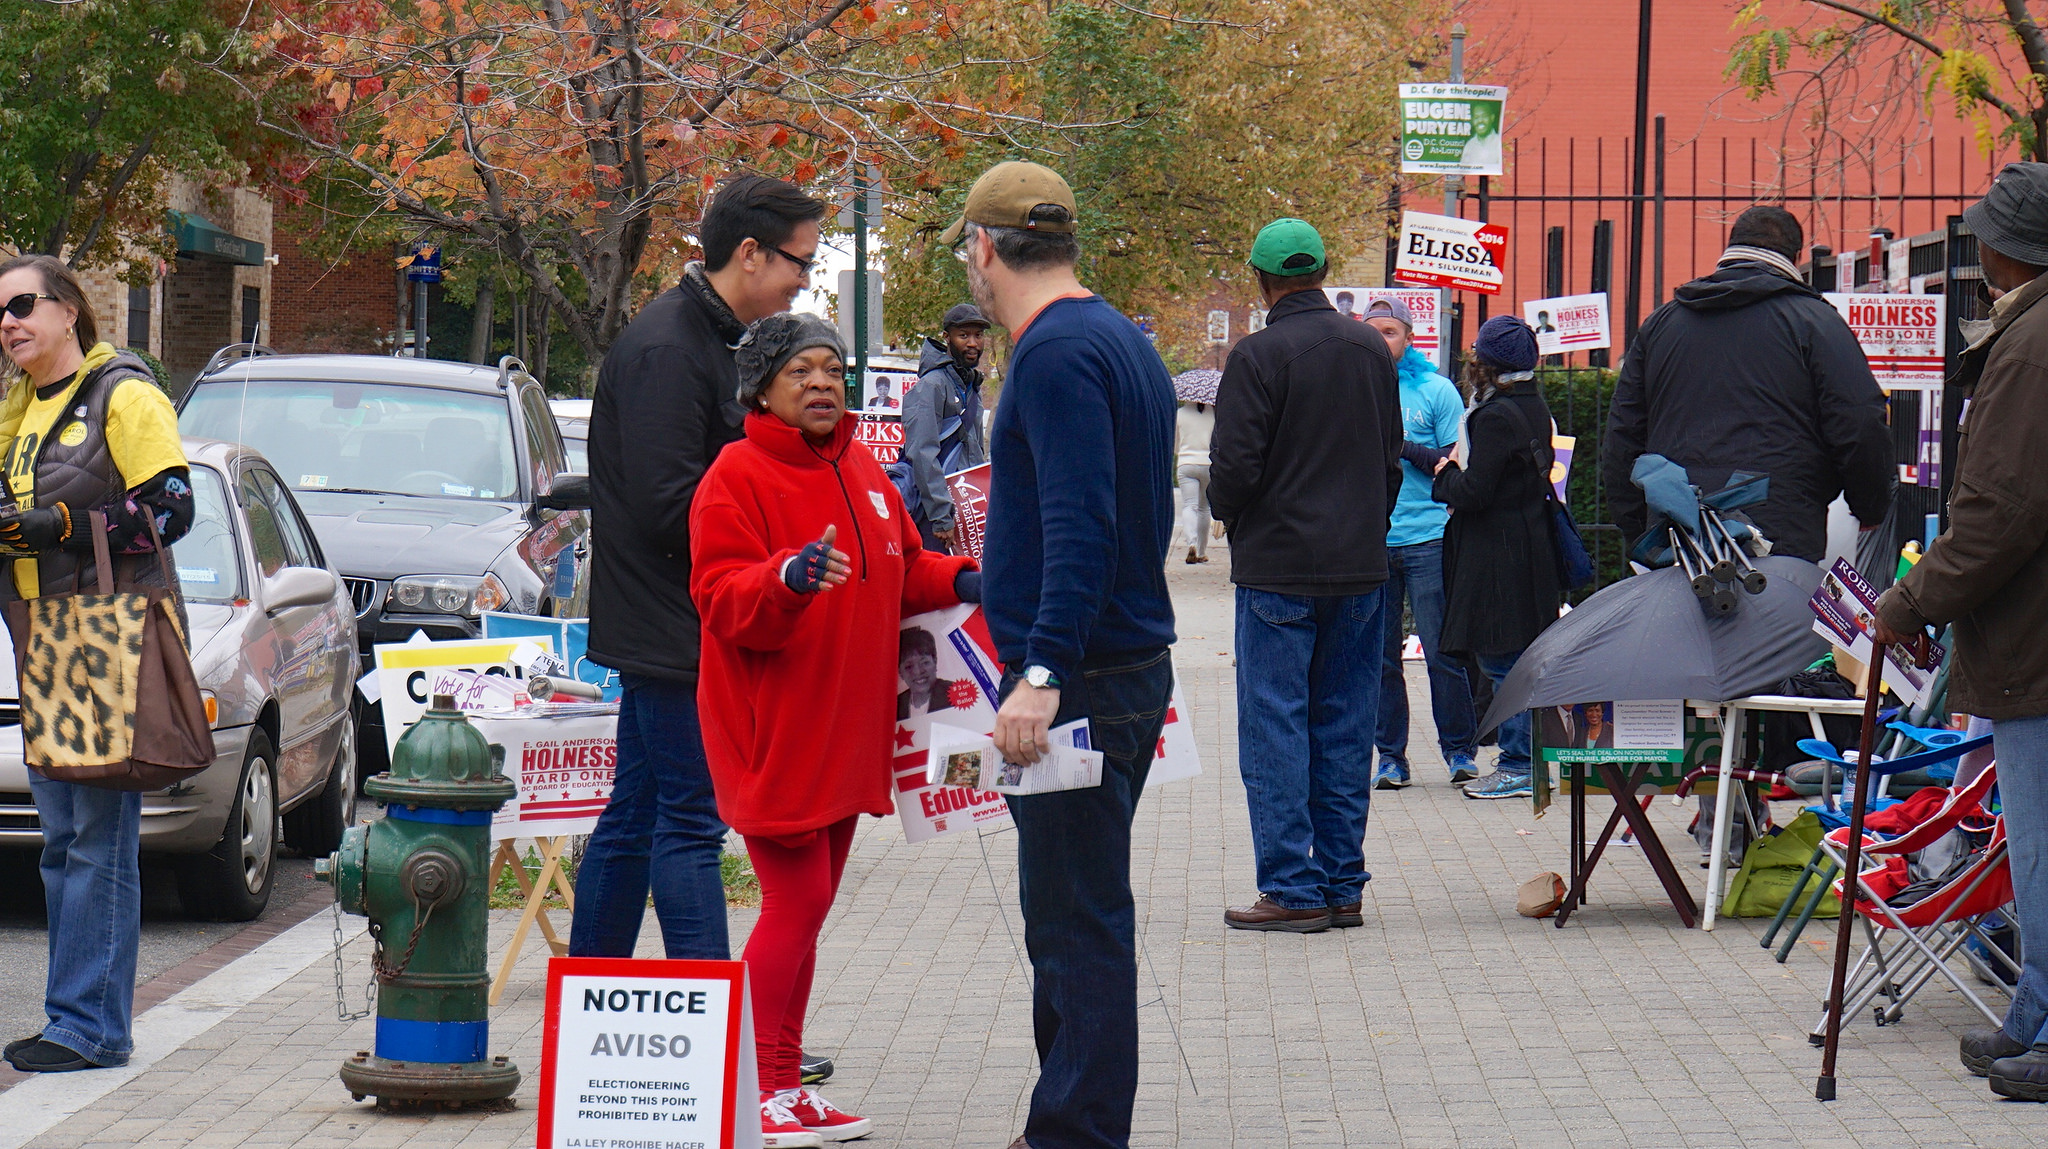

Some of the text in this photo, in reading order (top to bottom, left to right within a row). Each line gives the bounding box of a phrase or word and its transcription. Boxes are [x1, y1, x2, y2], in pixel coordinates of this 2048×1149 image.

[1411, 86, 1429, 94] D.C.
[1433, 86, 1446, 94] for
[1405, 102, 1471, 120] EUGENE
[1405, 120, 1471, 136] PURYEAR
[1423, 138, 1437, 146] D.C.
[1478, 232, 1504, 245] 2014
[1407, 232, 1497, 267] ELISSA
[1438, 263, 1492, 277] SILVERMAN
[1557, 308, 1599, 322] HOLNESS
[1849, 305, 1937, 327] HOLNESS
[1852, 329, 1936, 339] WARD ONE
[957, 524, 965, 542] Board
[961, 542, 967, 550] of
[960, 501, 980, 559] PERDOMO
[1842, 576, 1852, 587] DC
[434, 676, 464, 696] Vote
[466, 675, 489, 701] for
[957, 697, 973, 705] Ballot
[523, 738, 617, 749] E. GAIL ANDERSON
[522, 746, 617, 771] HOLNESS
[522, 770, 616, 785] WARD ONE
[919, 786, 1005, 819] Educa
[583, 988, 707, 1014] NOTICE
[590, 1033, 692, 1058] AVISO
[588, 1079, 690, 1091] ELECTIONEERING
[580, 1095, 697, 1107] BEYOND THIS POINT
[578, 1110, 697, 1122] PROHIBITED BY LAW
[567, 1138, 705, 1149] LA LEY PROHIBE HACER
